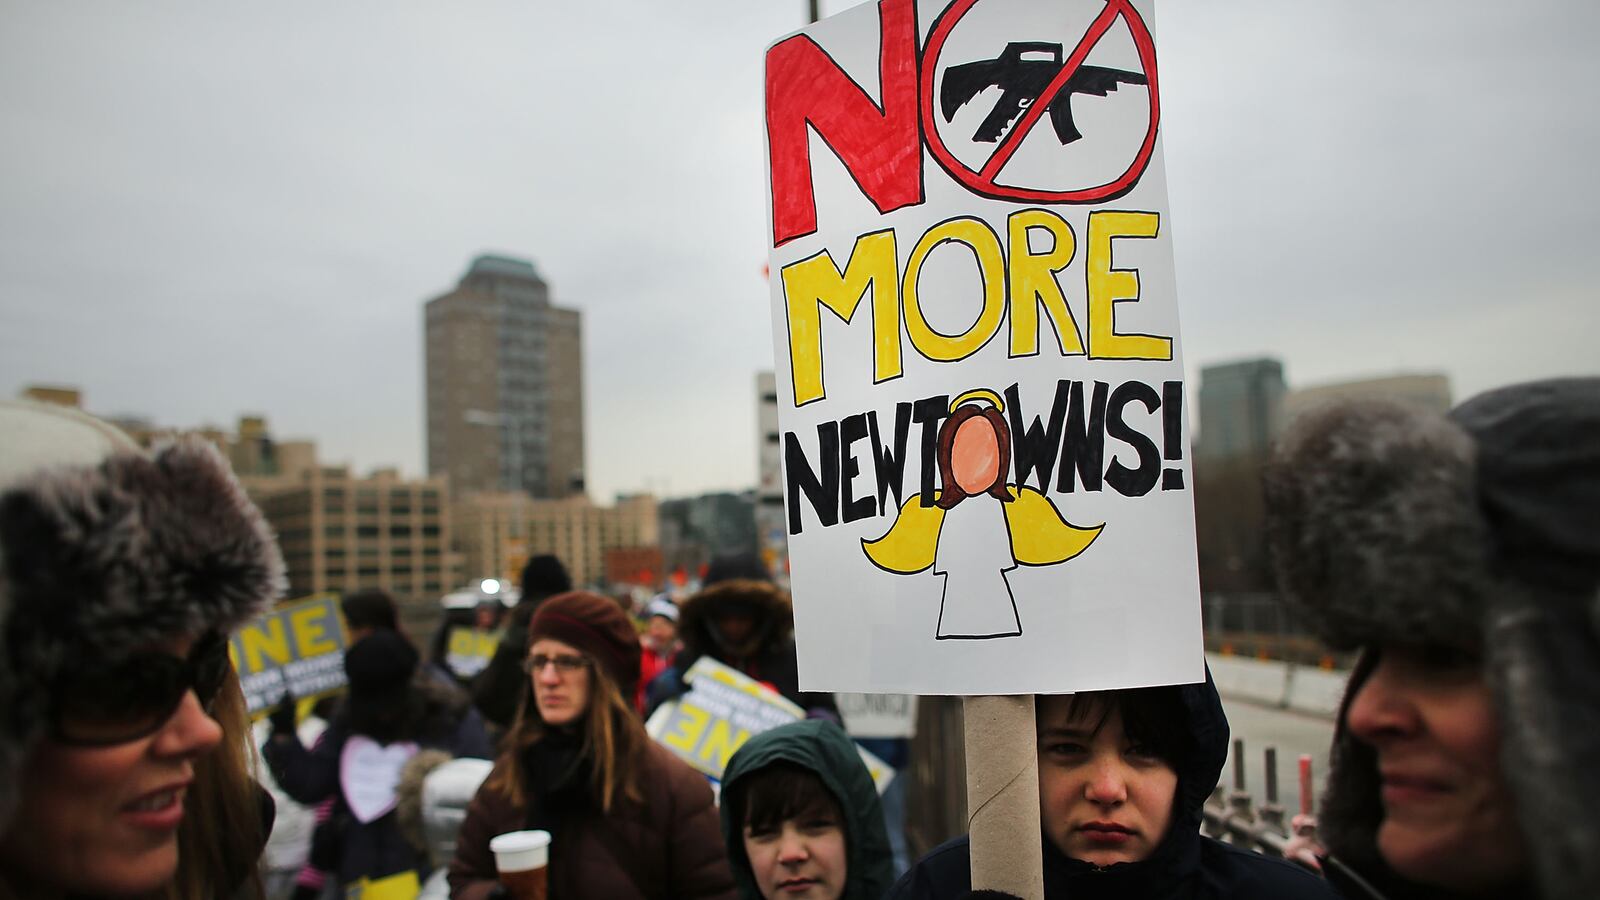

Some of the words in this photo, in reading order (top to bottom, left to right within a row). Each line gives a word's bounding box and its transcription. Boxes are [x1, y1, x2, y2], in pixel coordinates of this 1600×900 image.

[766, 0, 1160, 248] NO
[781, 208, 1173, 407] MORE
[228, 605, 337, 674] NE
[447, 629, 497, 657] ON
[664, 702, 749, 770] NE
